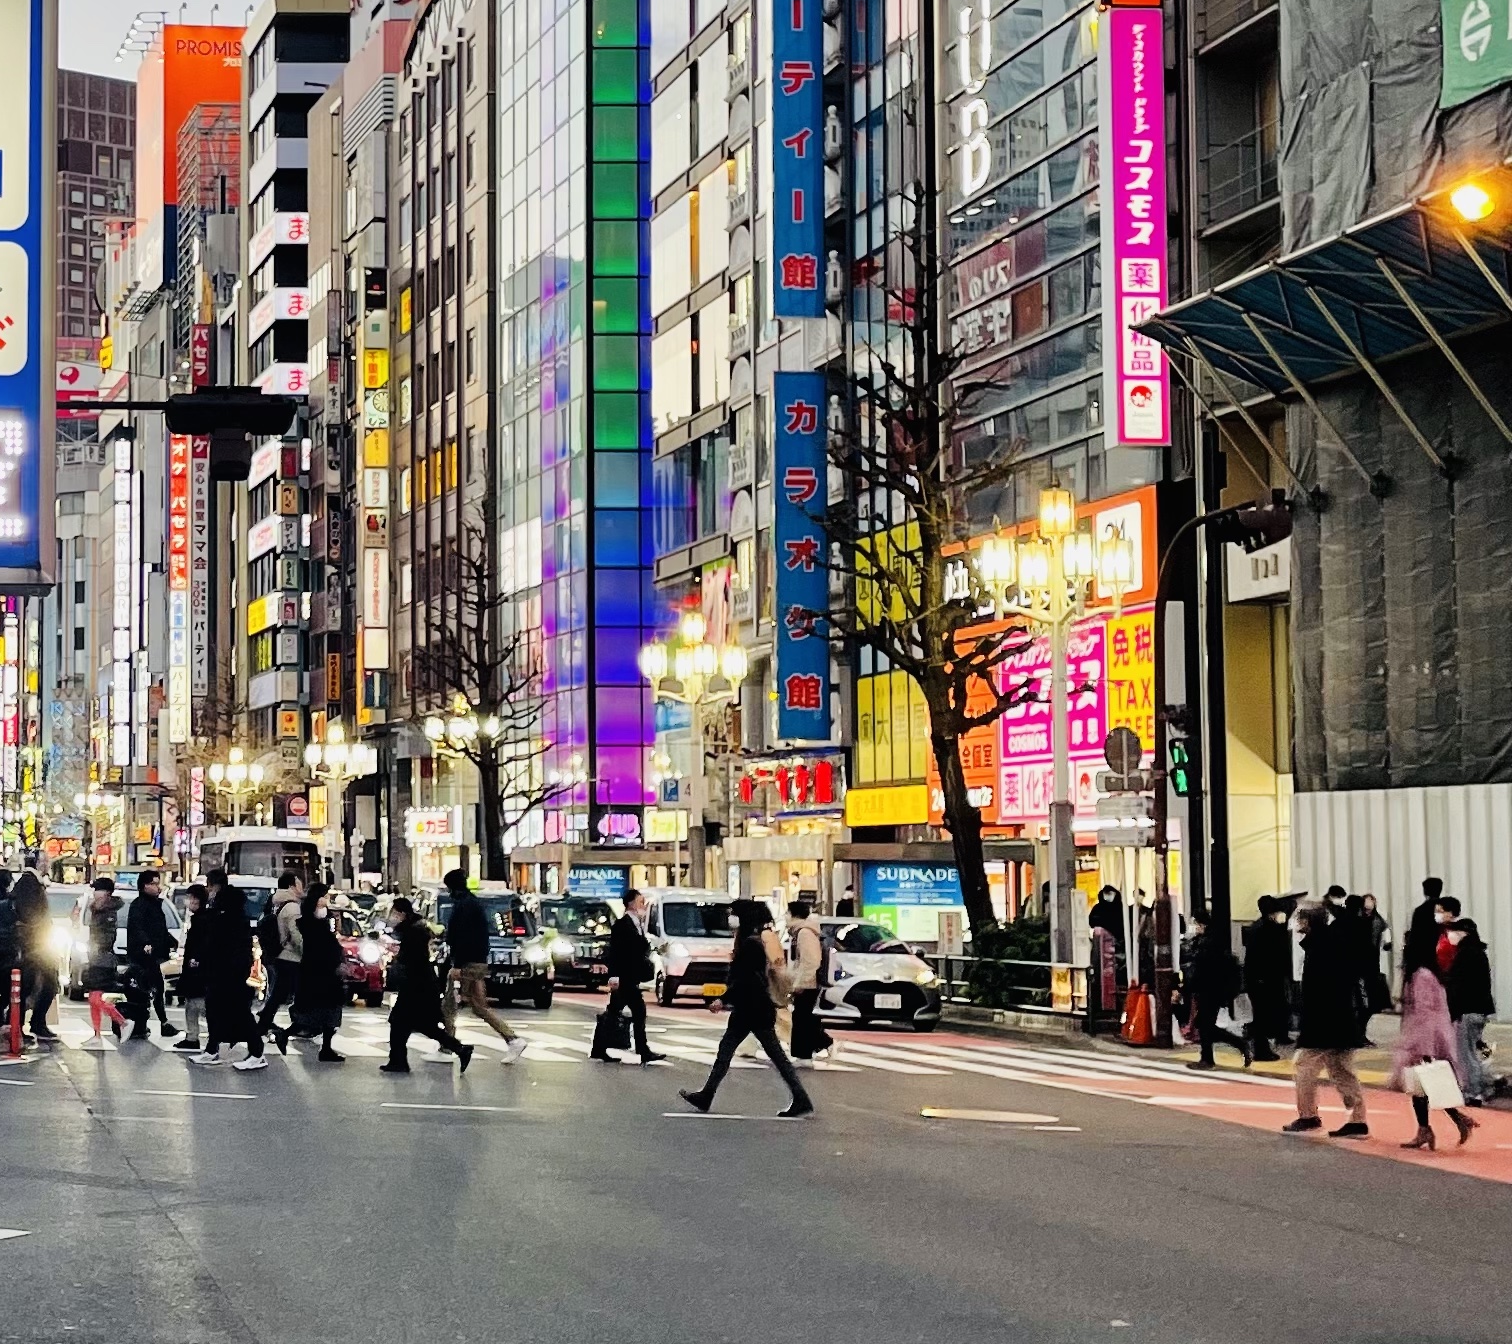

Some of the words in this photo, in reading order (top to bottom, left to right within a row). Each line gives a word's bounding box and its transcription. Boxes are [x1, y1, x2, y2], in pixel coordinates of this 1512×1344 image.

[1123, 140, 1155, 245] コスモス
[1128, 263, 1153, 288] 薬
[193, 328, 209, 376] パセラ
[784, 401, 823, 711] カラオケ館
[1112, 624, 1153, 668] 免税
[1114, 676, 1153, 711] TAX
[1010, 732, 1048, 754] COSMOS
[666, 781, 677, 793] P
[876, 867, 958, 882] SUBNADE
